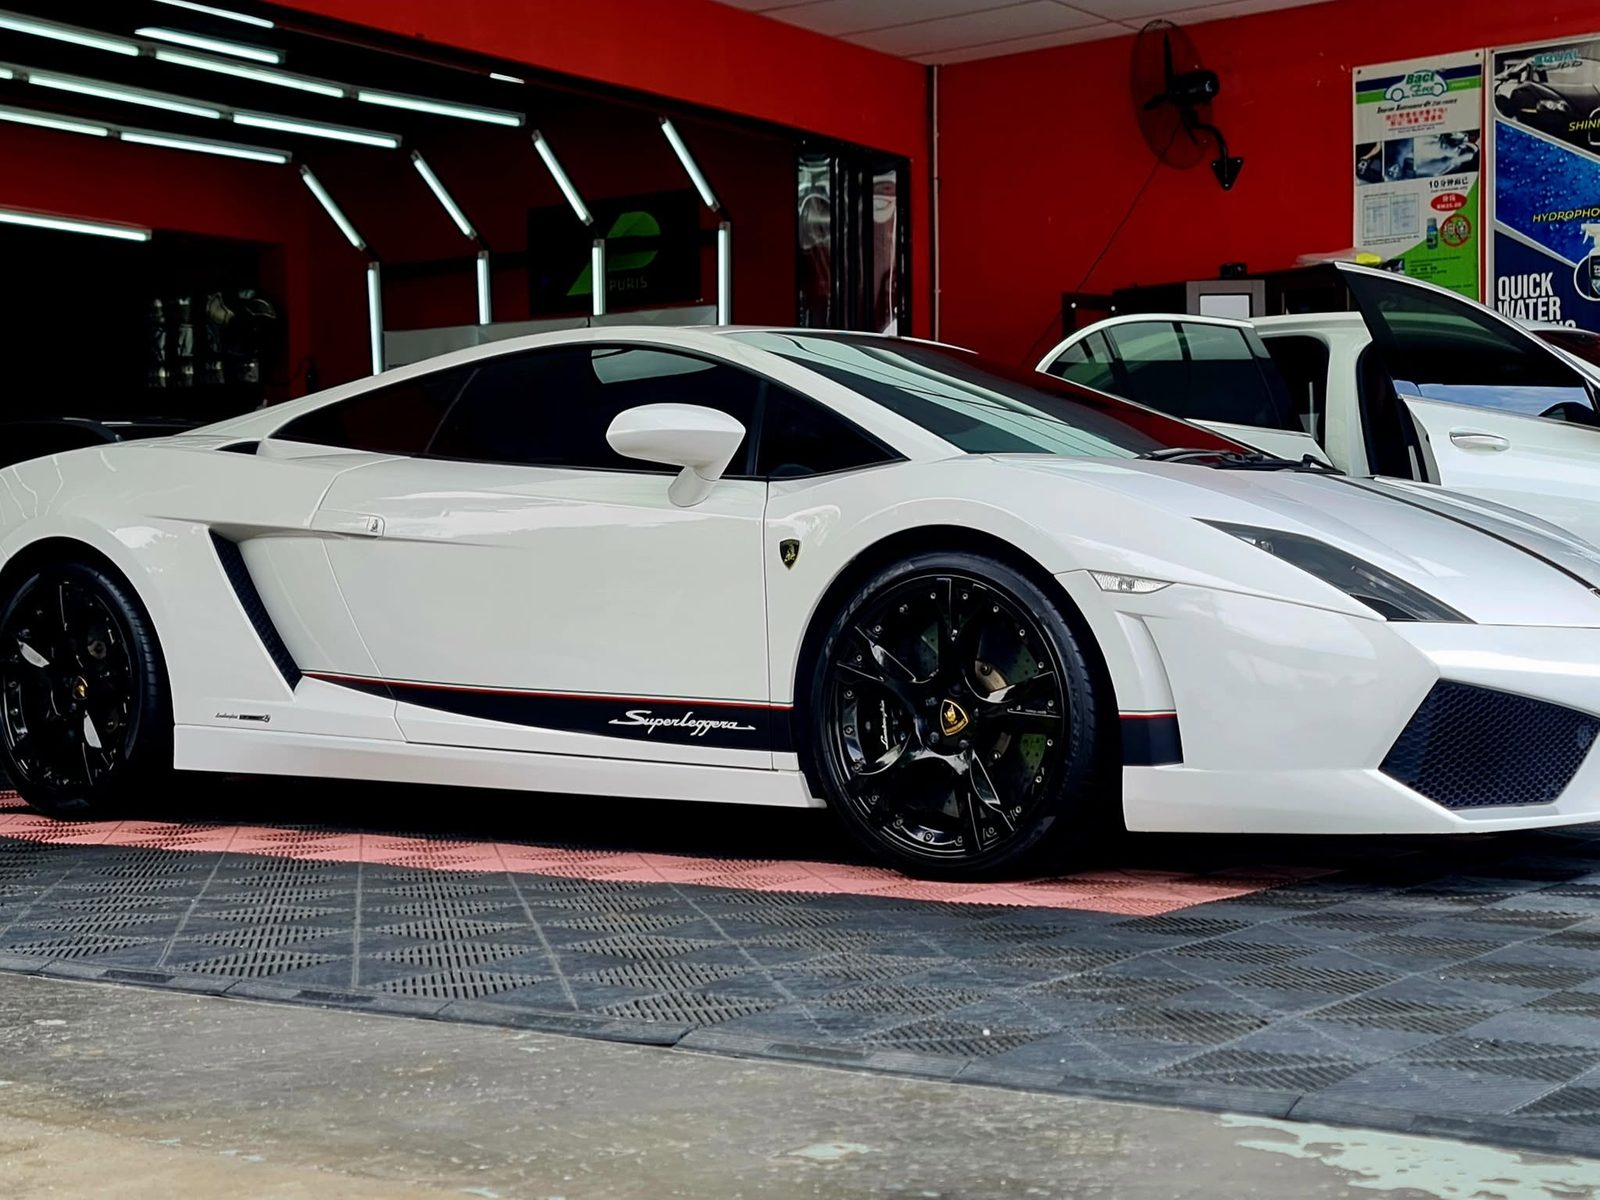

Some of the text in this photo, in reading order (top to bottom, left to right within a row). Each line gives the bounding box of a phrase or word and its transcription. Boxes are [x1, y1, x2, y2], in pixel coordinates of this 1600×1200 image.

[609, 277, 648, 291] PURIS
[1498, 271, 1553, 301] QUICK
[1497, 296, 1561, 321] WATER
[608, 709, 756, 737] Superleggera
